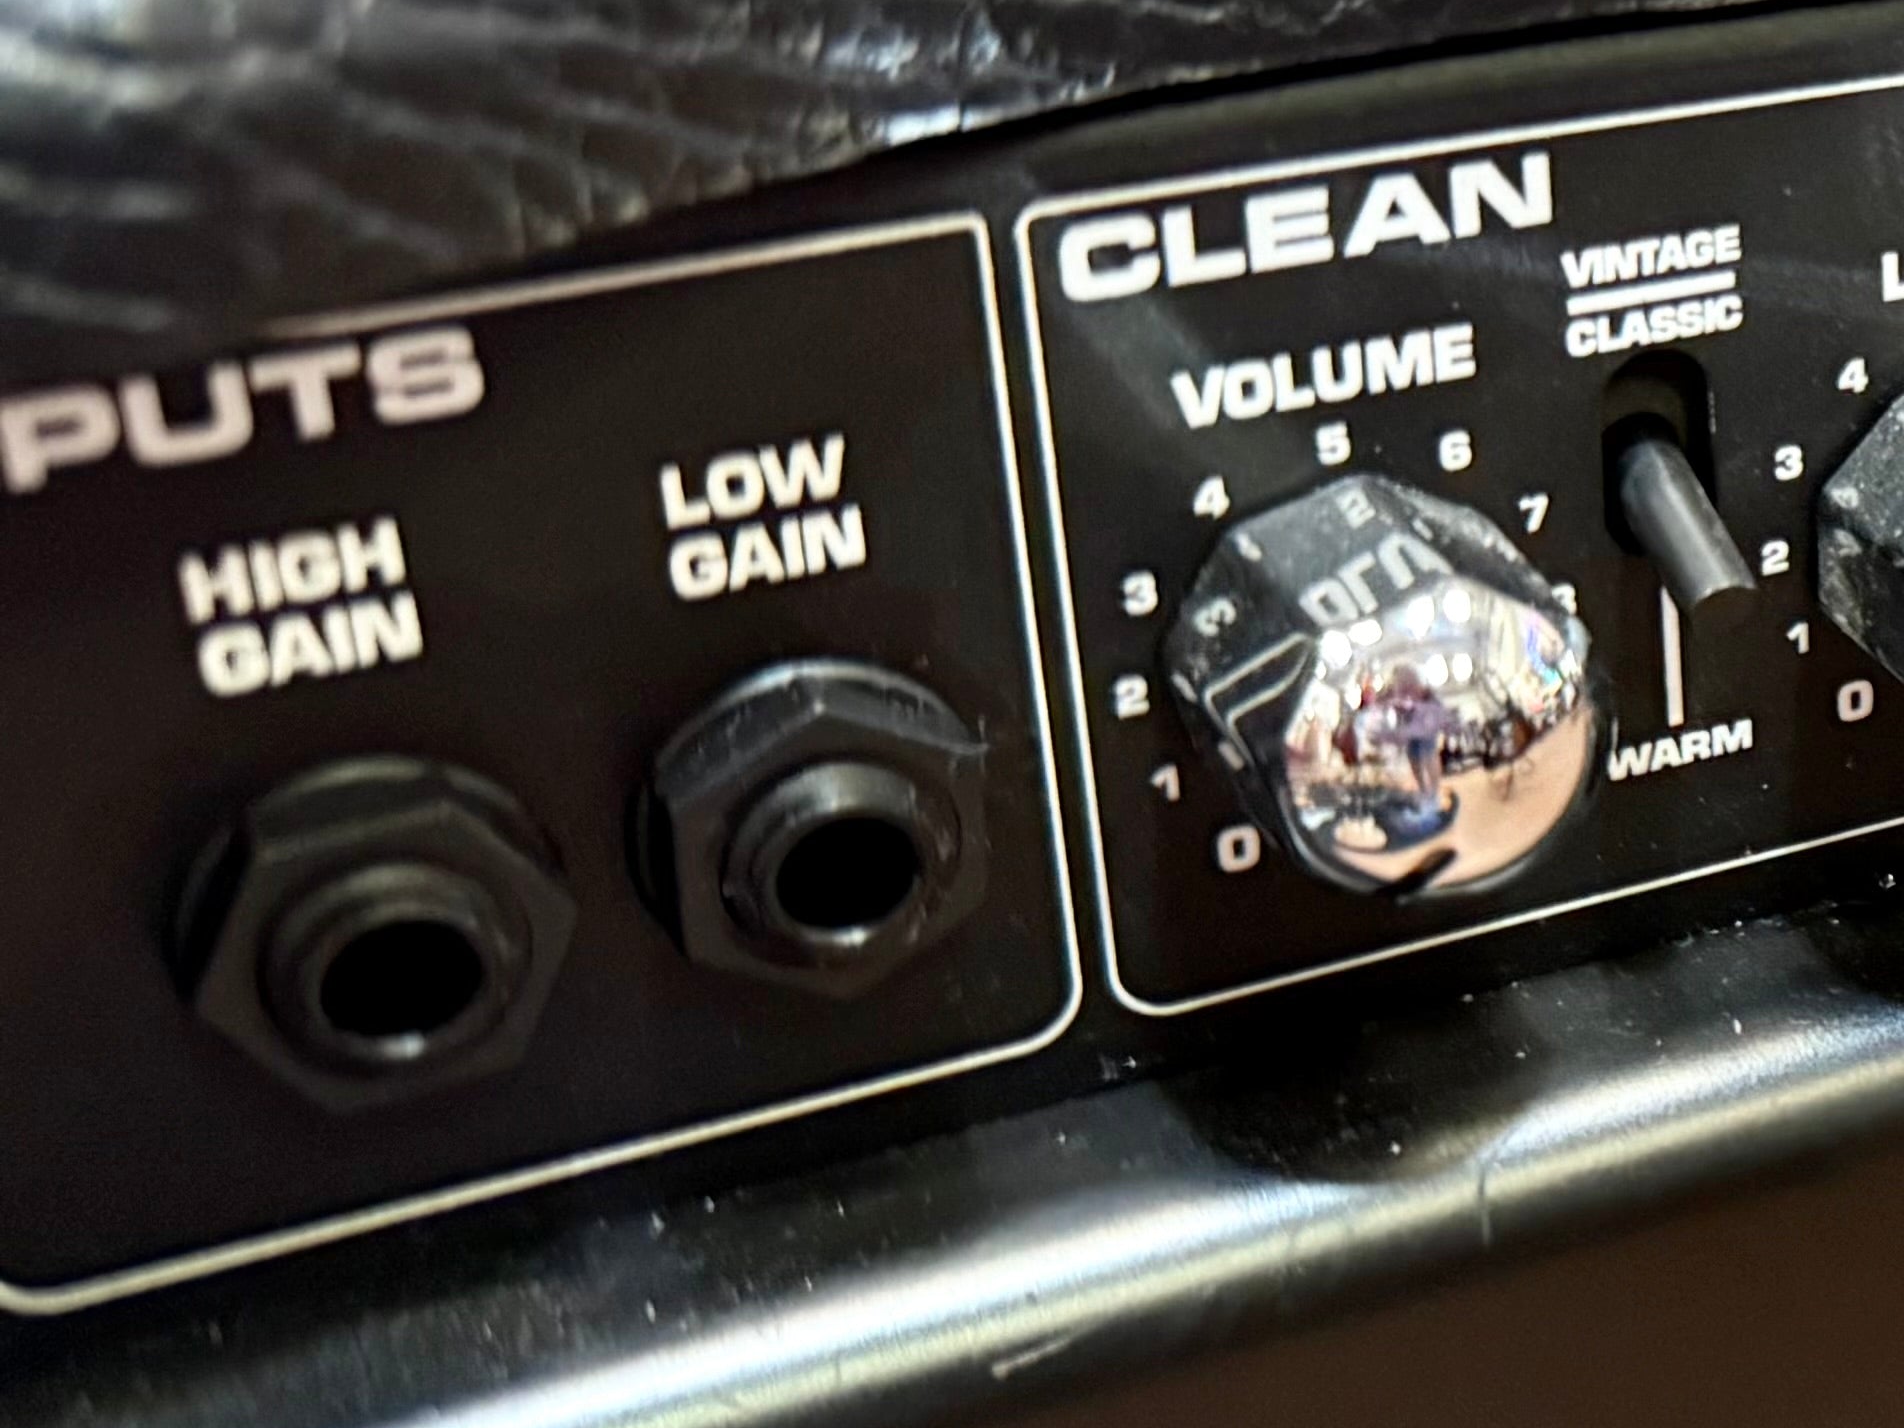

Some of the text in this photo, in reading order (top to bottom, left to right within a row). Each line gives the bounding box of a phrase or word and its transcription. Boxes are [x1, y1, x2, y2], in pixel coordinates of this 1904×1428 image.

[1058, 152, 1553, 302] CLEAN
[1560, 224, 1741, 289] VINTAGE
[1566, 294, 1743, 357] CLASSIC
[1170, 324, 1475, 428] VOLUME
[1838, 358, 1868, 392] 4
[1316, 423, 1350, 465] 5
[1439, 431, 1472, 471] 6
[1775, 445, 1803, 480] 3
[661, 434, 846, 529] LOW
[1194, 476, 1229, 517] 4
[1519, 494, 1548, 532] 7
[180, 515, 407, 624] HIGH
[668, 504, 866, 600] GAIN
[1762, 540, 1789, 575] 2
[1123, 573, 1157, 615] 3
[198, 591, 424, 696] GAIN
[1787, 623, 1808, 653] 1
[1115, 676, 1149, 718] 2
[1838, 680, 1873, 721] 0
[1608, 719, 1752, 780] WARM
[1152, 766, 1179, 799] 1
[1218, 826, 1259, 871] 0
